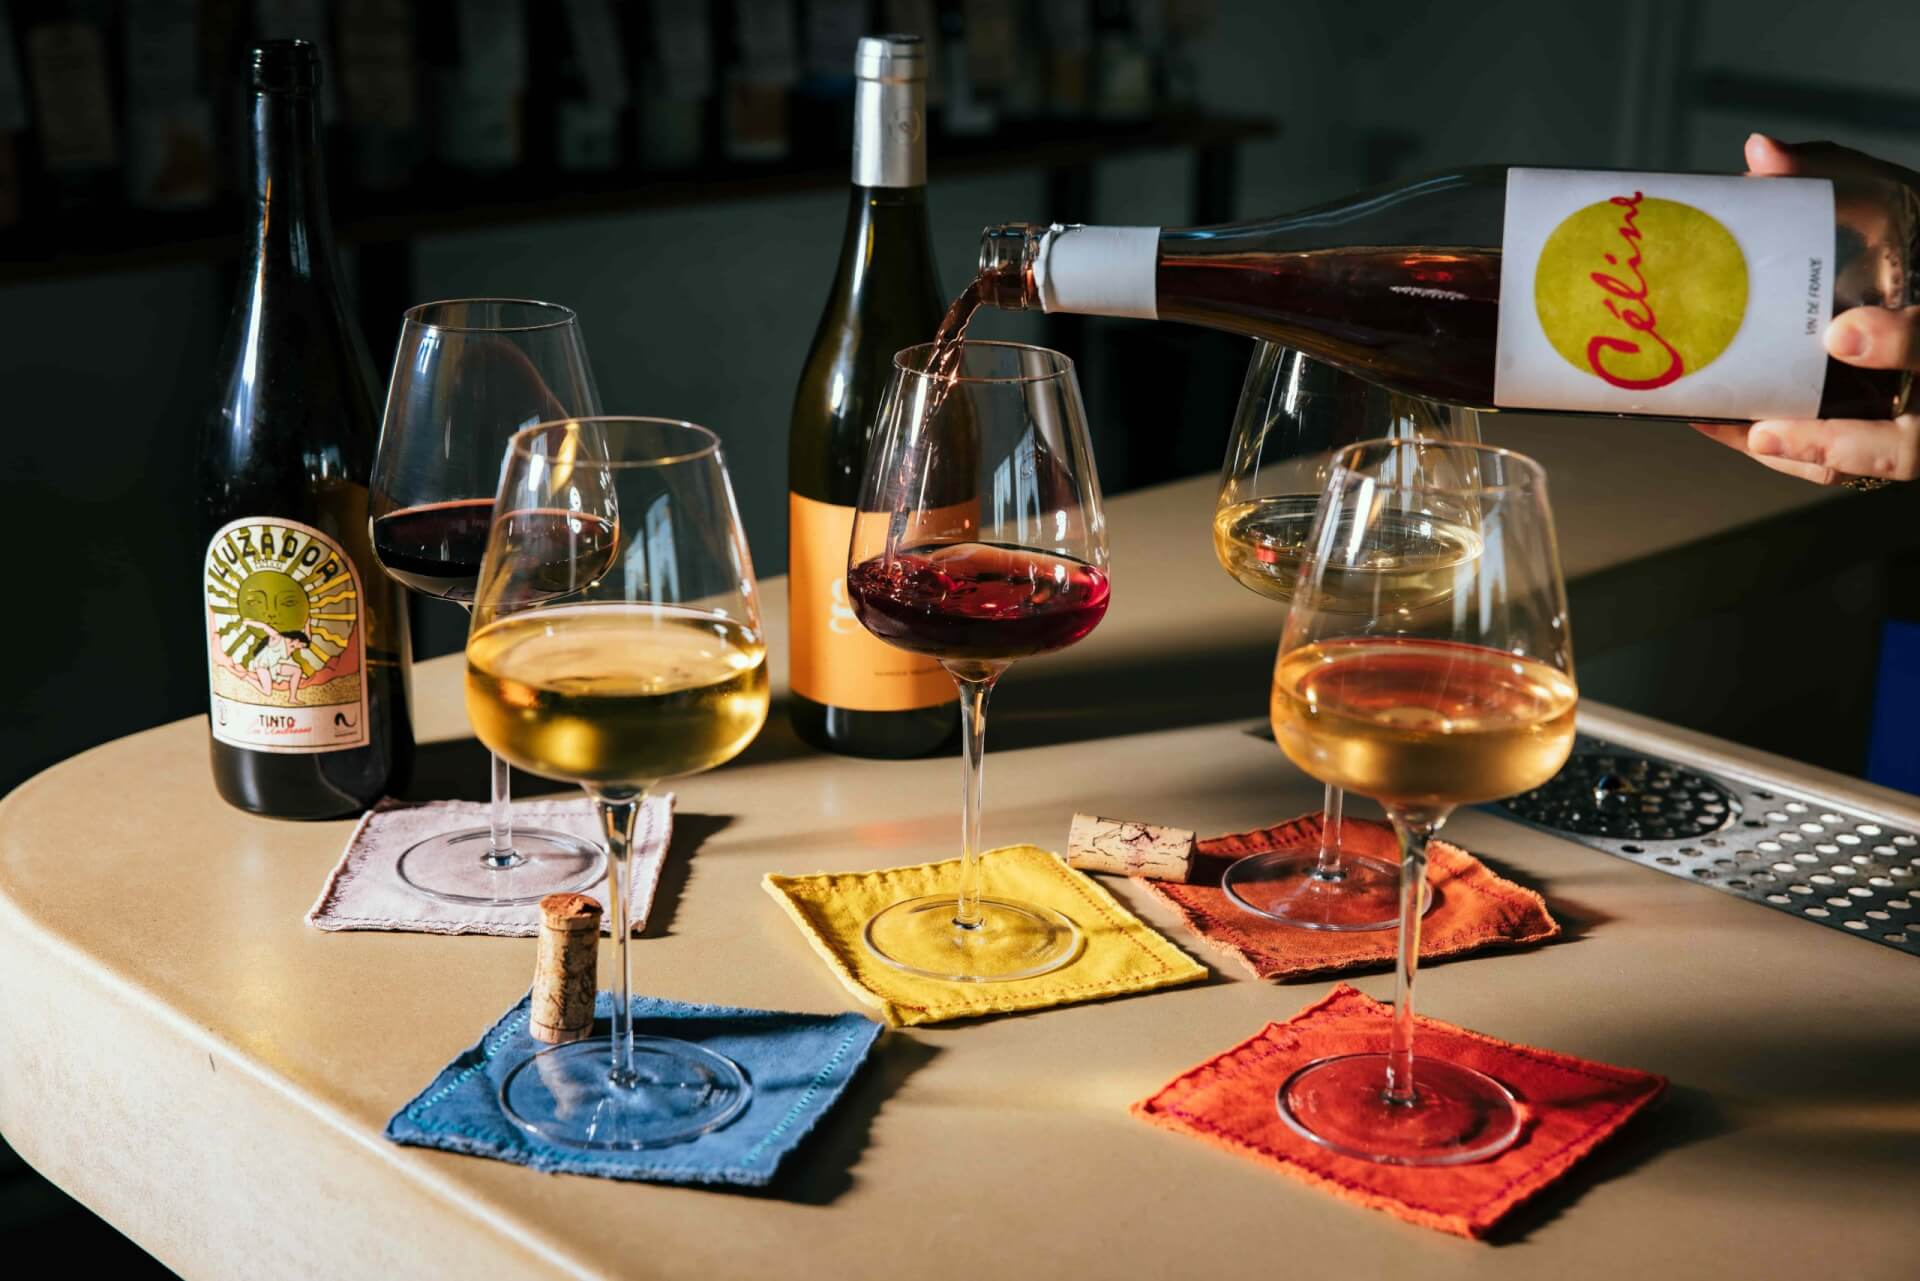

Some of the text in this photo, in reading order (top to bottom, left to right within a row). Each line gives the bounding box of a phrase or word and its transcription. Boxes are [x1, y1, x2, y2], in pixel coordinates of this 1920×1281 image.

[1587, 190, 1684, 390] Céline
[1805, 257, 1823, 336] VIN DE FRANCE
[213, 532, 338, 582] LUZADOR
[258, 714, 297, 729] TINTO
